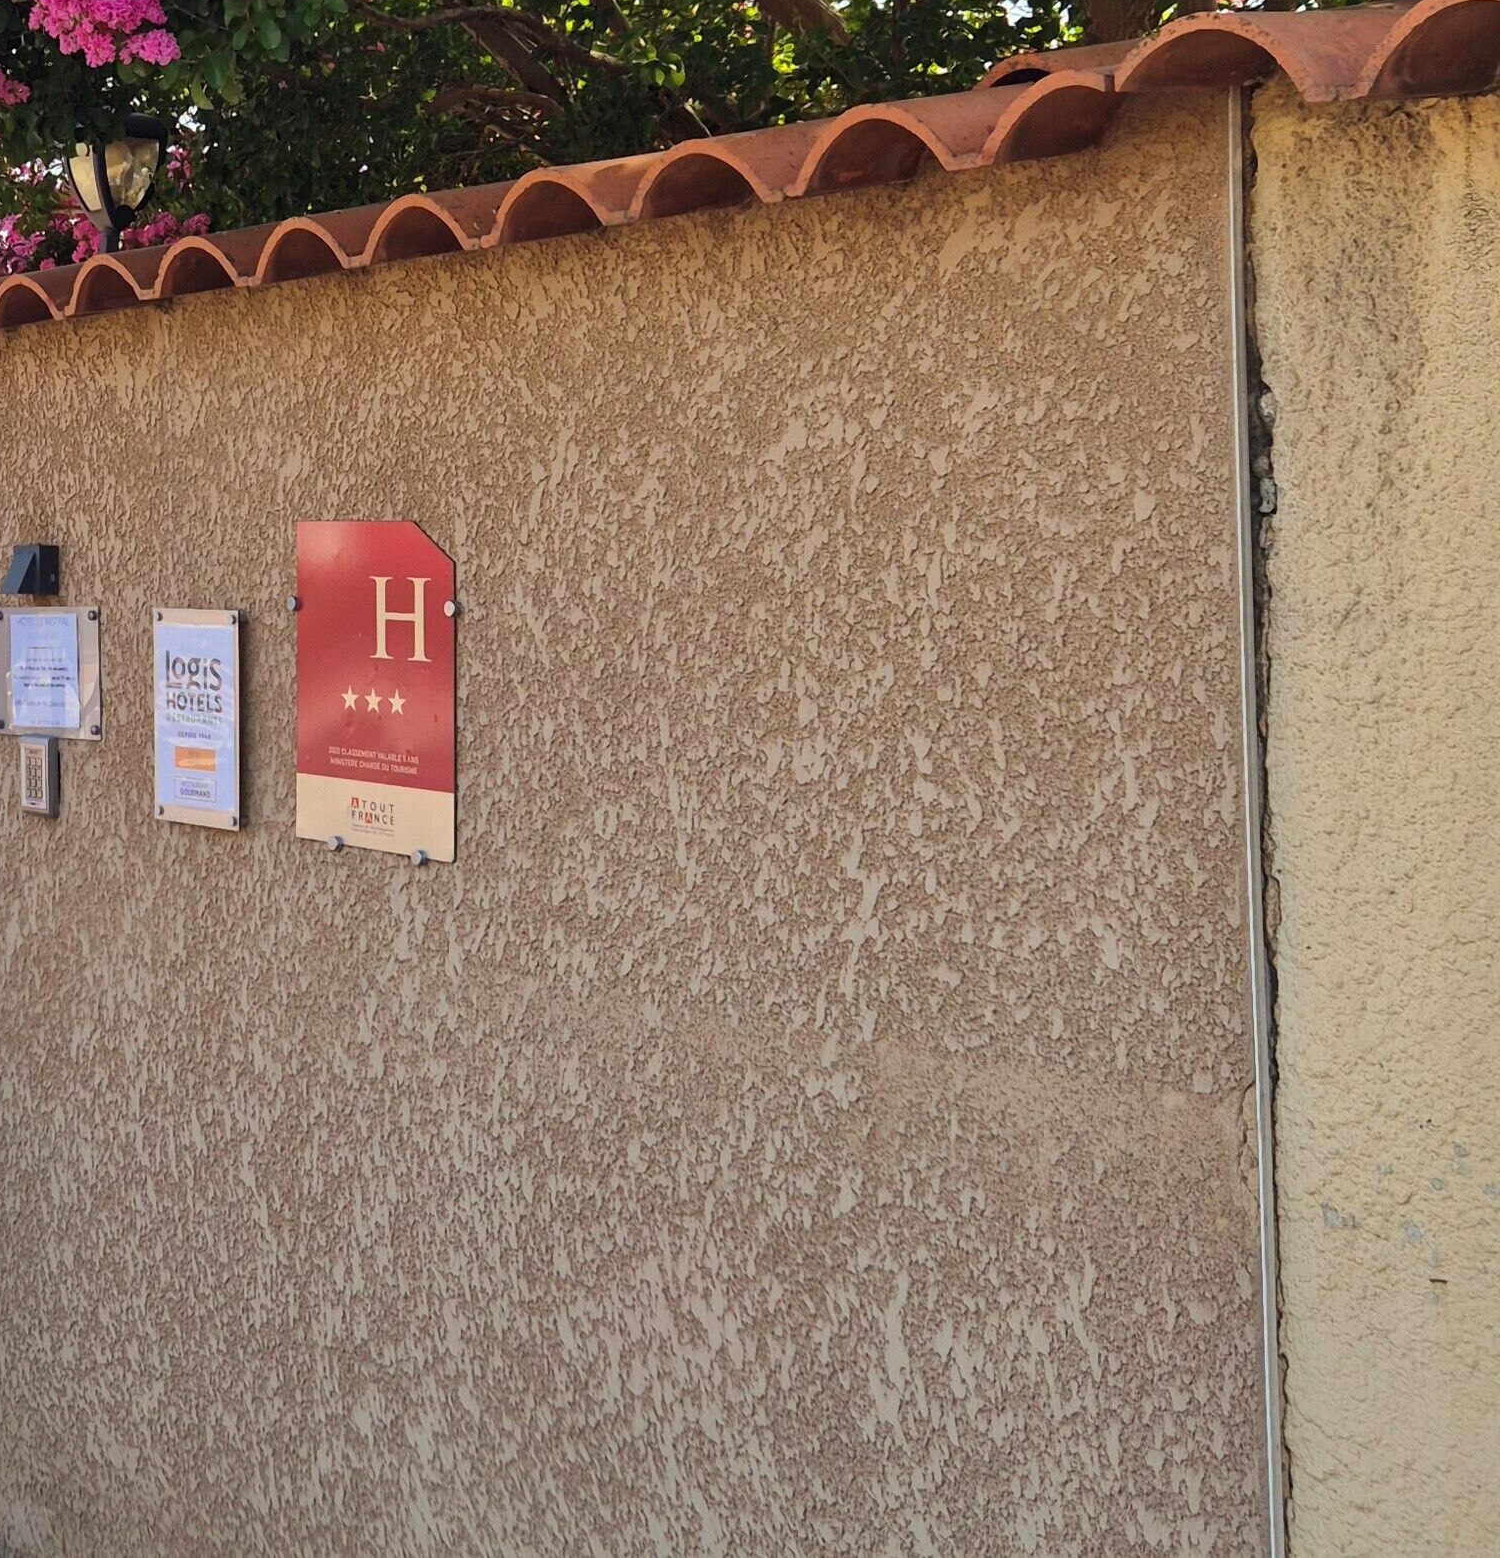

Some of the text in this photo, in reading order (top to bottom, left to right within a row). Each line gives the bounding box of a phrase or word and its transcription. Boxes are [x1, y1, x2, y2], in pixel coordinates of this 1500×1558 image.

[369, 575, 432, 662] H
[166, 690, 223, 713] HOTELS
[351, 809, 395, 826] FRANCE
